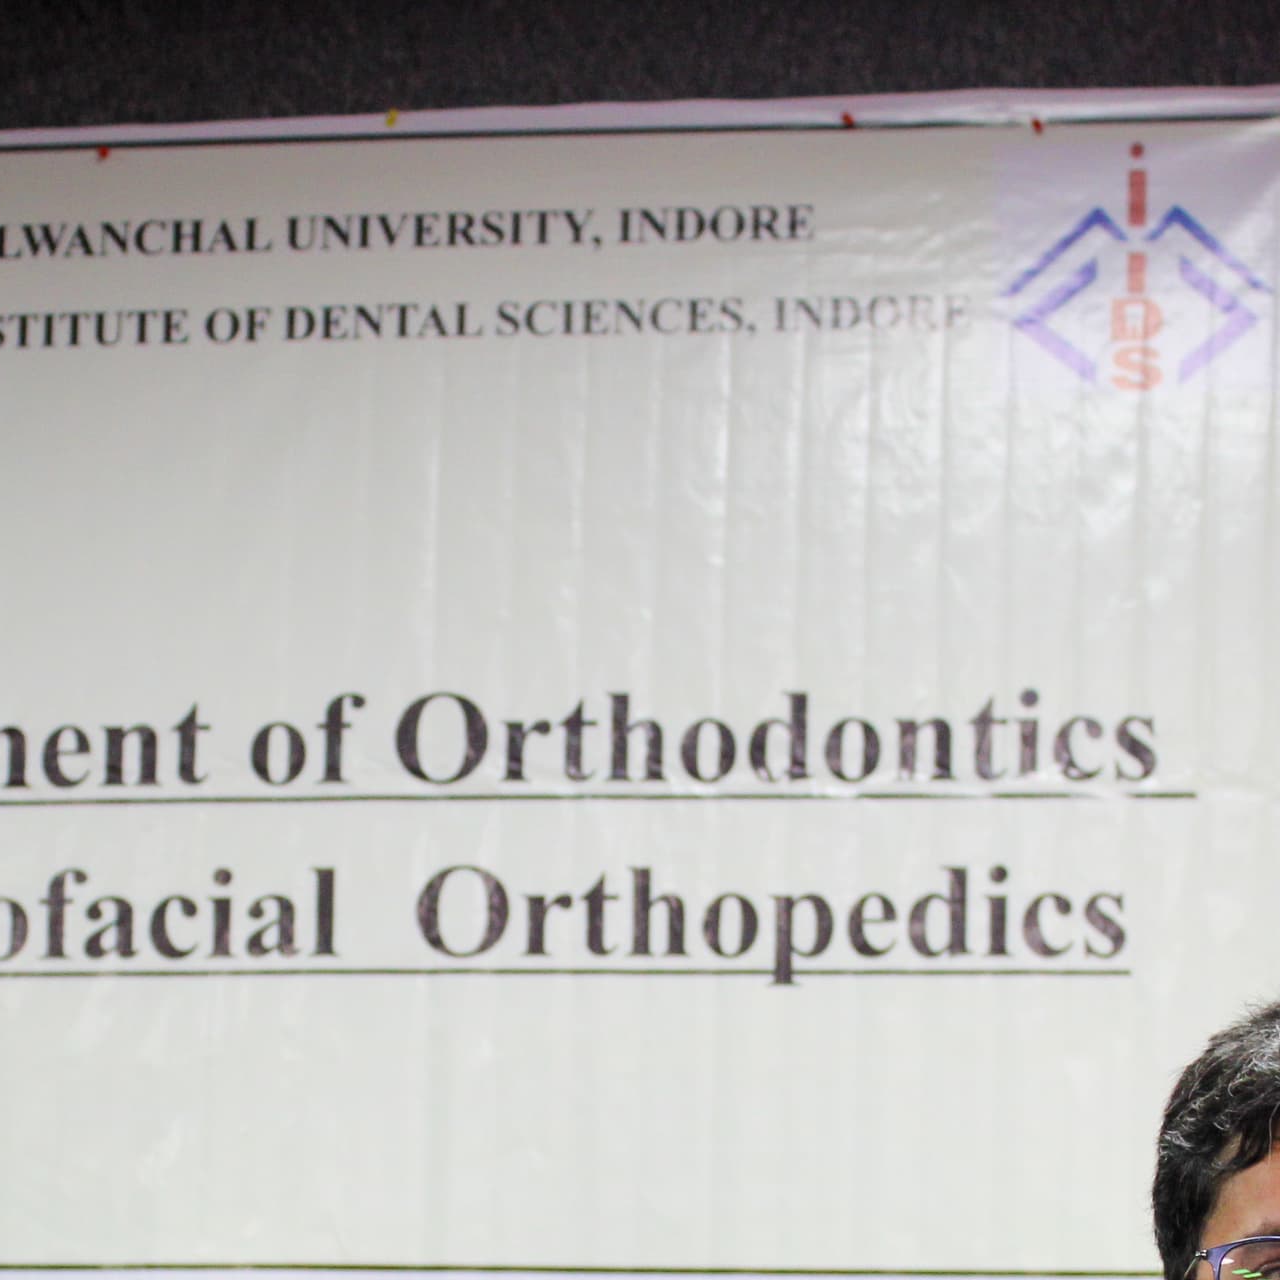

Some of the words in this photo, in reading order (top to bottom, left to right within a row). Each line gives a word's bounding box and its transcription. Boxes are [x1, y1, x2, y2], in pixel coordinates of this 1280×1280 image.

[287, 208, 602, 251] UNIVERSITY,
[619, 204, 814, 244] INDORE
[204, 306, 271, 343] OF
[285, 302, 483, 341] DENTAL
[495, 298, 757, 338] SCIENCES,
[250, 692, 366, 787] of
[394, 688, 1158, 787] Orthodontics
[416, 863, 1131, 986] Orthopedics
